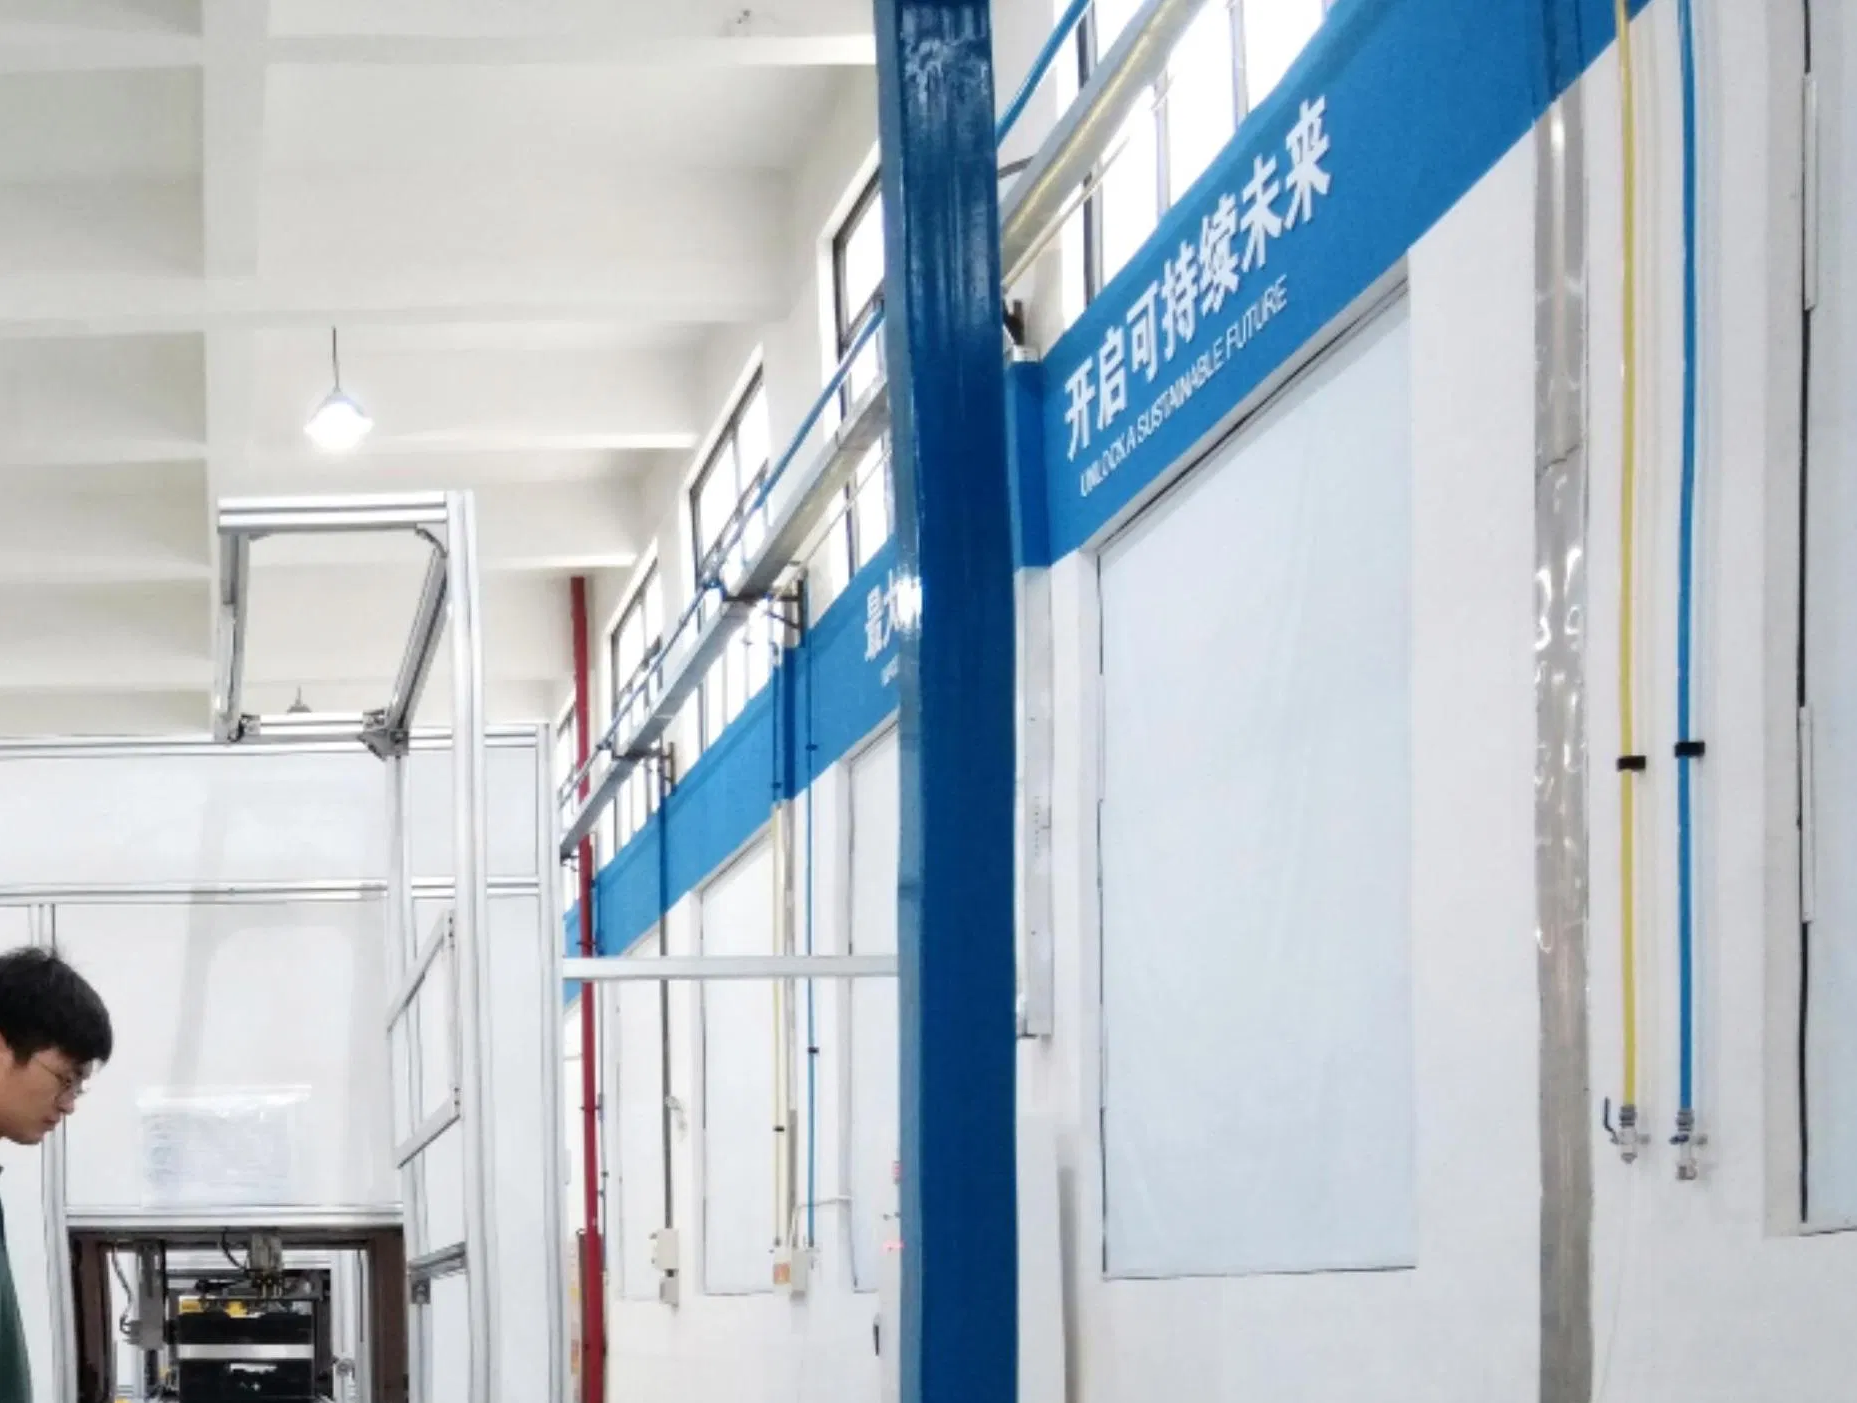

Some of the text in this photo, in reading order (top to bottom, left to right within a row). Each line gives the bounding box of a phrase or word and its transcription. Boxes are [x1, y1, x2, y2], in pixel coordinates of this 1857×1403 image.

[1064, 95, 1331, 461] 开启可持续未来
[1080, 433, 1127, 497] UNLOCK
[1137, 336, 1224, 444] SUSTAINABLE
[1226, 274, 1288, 360] FUTURE
